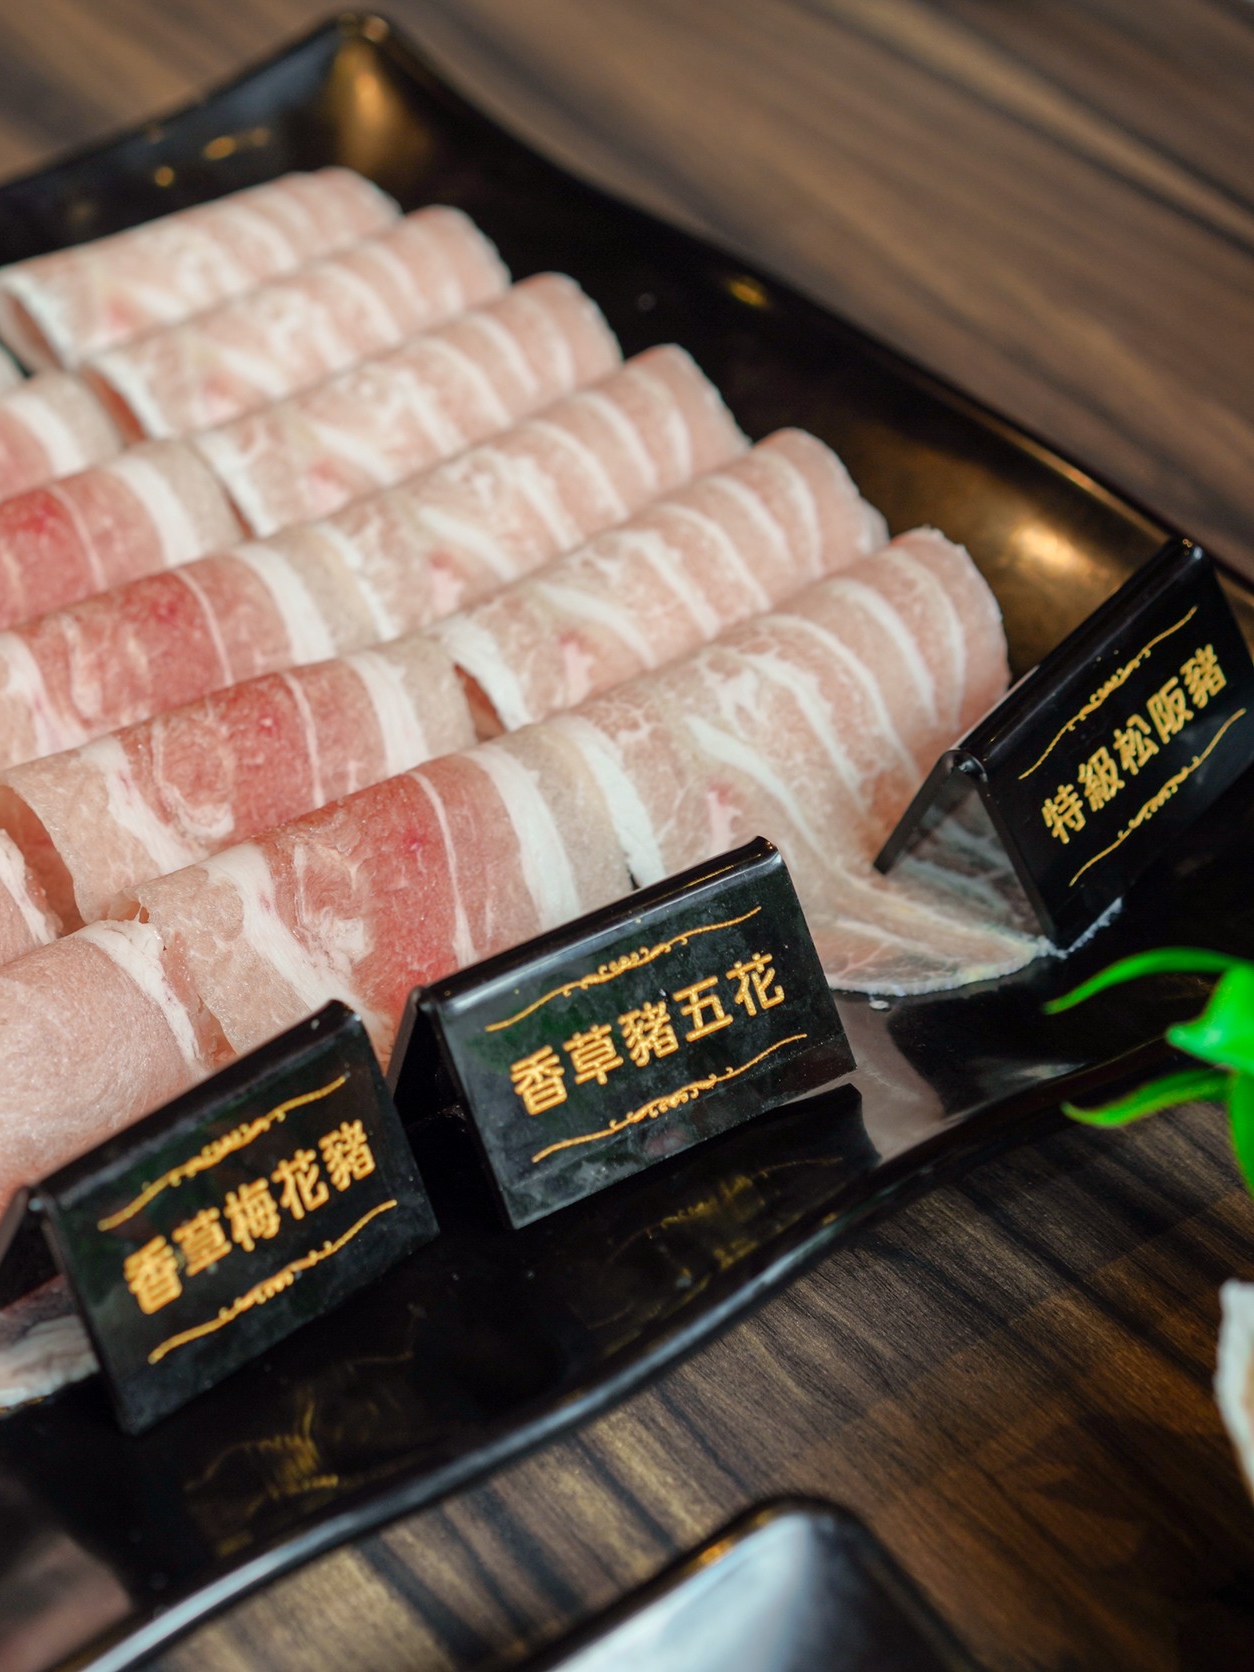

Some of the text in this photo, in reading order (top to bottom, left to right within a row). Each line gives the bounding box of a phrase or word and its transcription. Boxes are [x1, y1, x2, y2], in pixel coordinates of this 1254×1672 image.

[1041, 643, 1227, 844] 特級松阪豬
[509, 952, 785, 1116] 香草豬五花
[123, 1119, 376, 1315] 香草梅花豬
